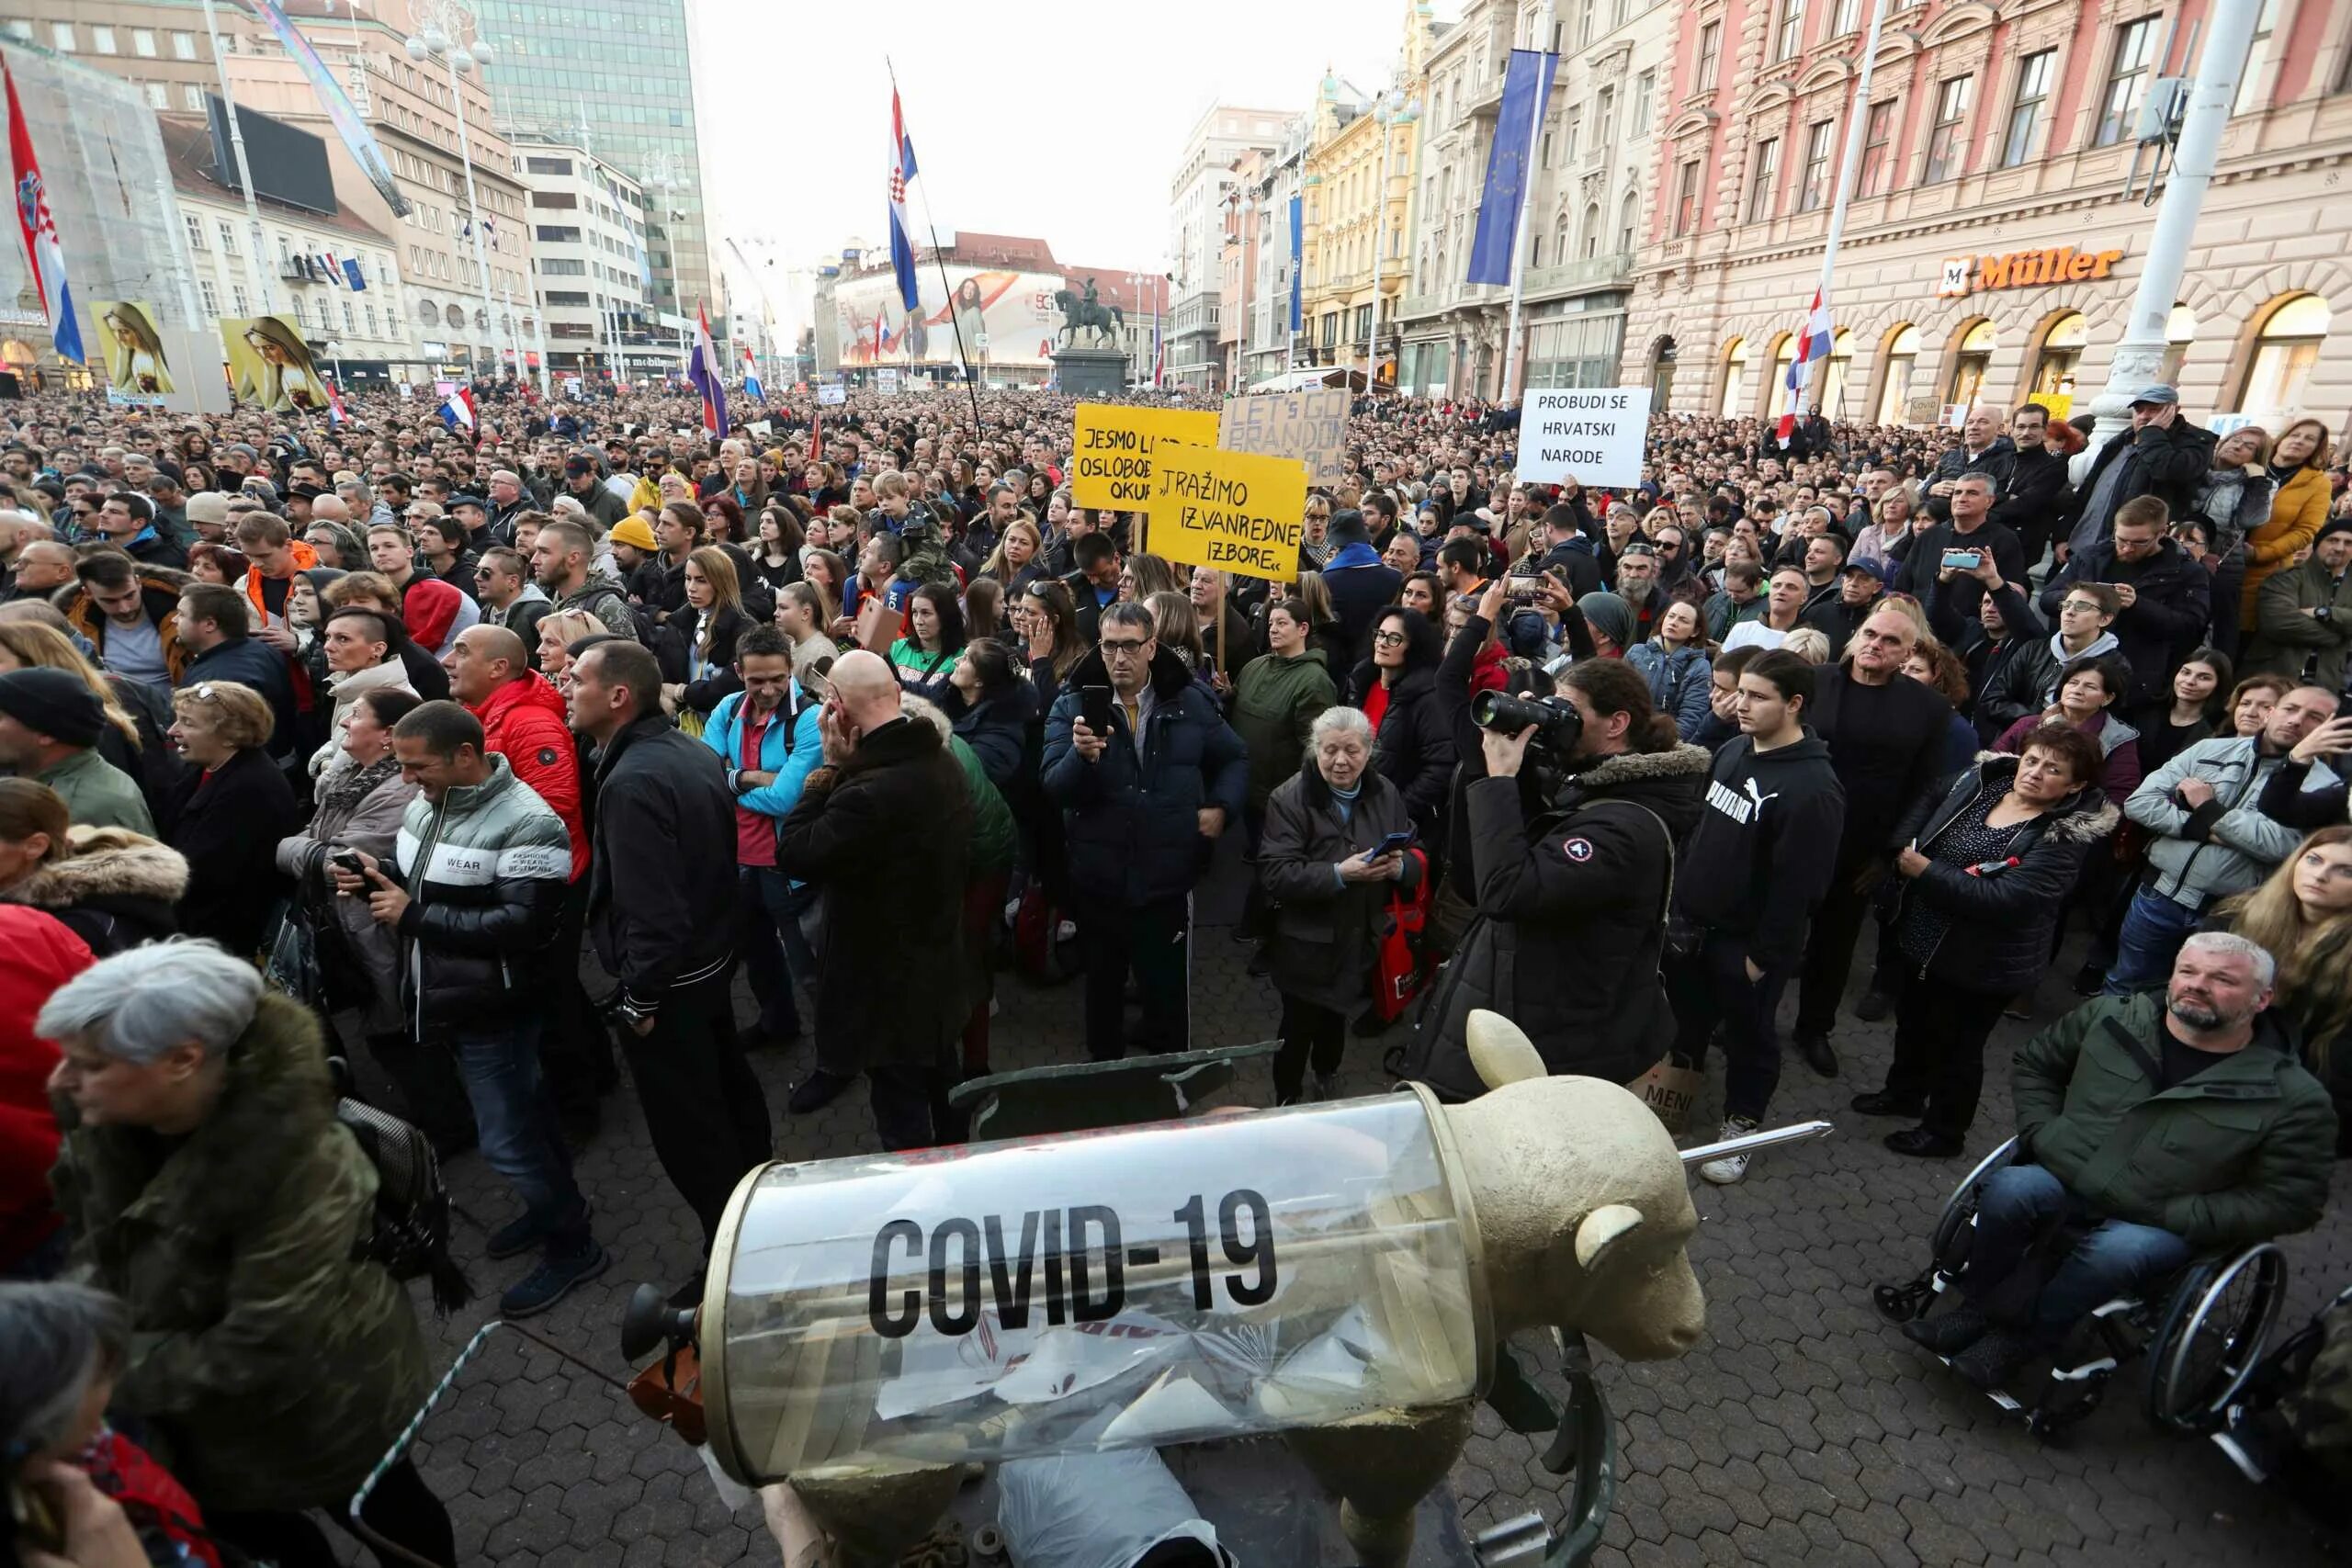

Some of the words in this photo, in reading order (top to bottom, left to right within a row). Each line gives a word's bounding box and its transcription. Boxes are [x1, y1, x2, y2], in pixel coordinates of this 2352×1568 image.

[1976, 245, 2124, 290] Müller
[1304, 390, 1345, 420] GO
[1538, 395, 1606, 409] PROBUDI
[1610, 395, 1629, 409] SE
[1083, 428, 1136, 450] JESMO
[1543, 422, 1616, 436] HRVATSKI
[1541, 448, 1603, 465] NARODE
[1181, 506, 1302, 547] IZVANREDNE
[1704, 780, 1753, 825] PUMA
[447, 857, 481, 871] WEAR
[868, 1189, 1278, 1339] COVID-19
